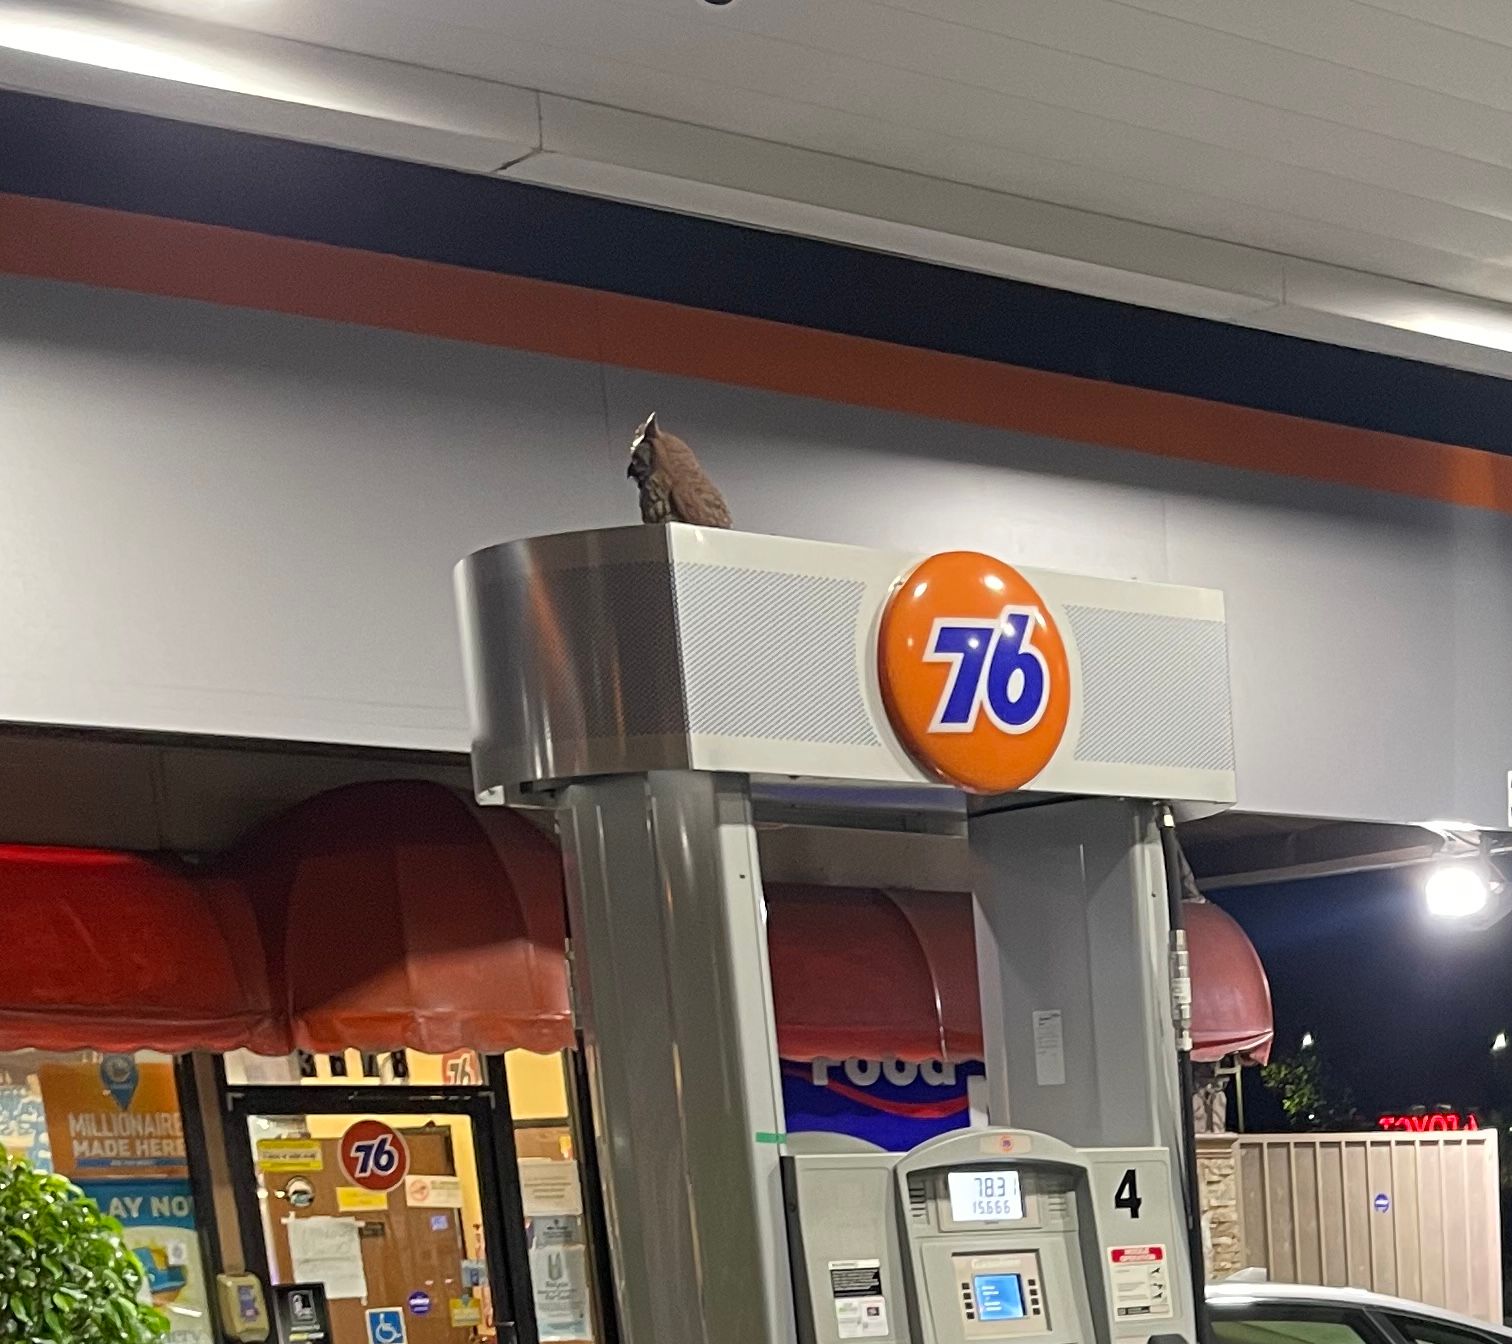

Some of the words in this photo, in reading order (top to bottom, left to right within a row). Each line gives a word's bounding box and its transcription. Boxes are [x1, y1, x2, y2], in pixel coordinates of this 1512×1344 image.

[923, 604, 1050, 735] 76
[69, 1112, 183, 1137] MILLIONAIRE
[73, 1139, 131, 1157] MADE
[135, 1138, 186, 1156] HERE
[351, 1134, 400, 1178] 76
[151, 1196, 194, 1218] NO
[1114, 1169, 1142, 1219] 4
